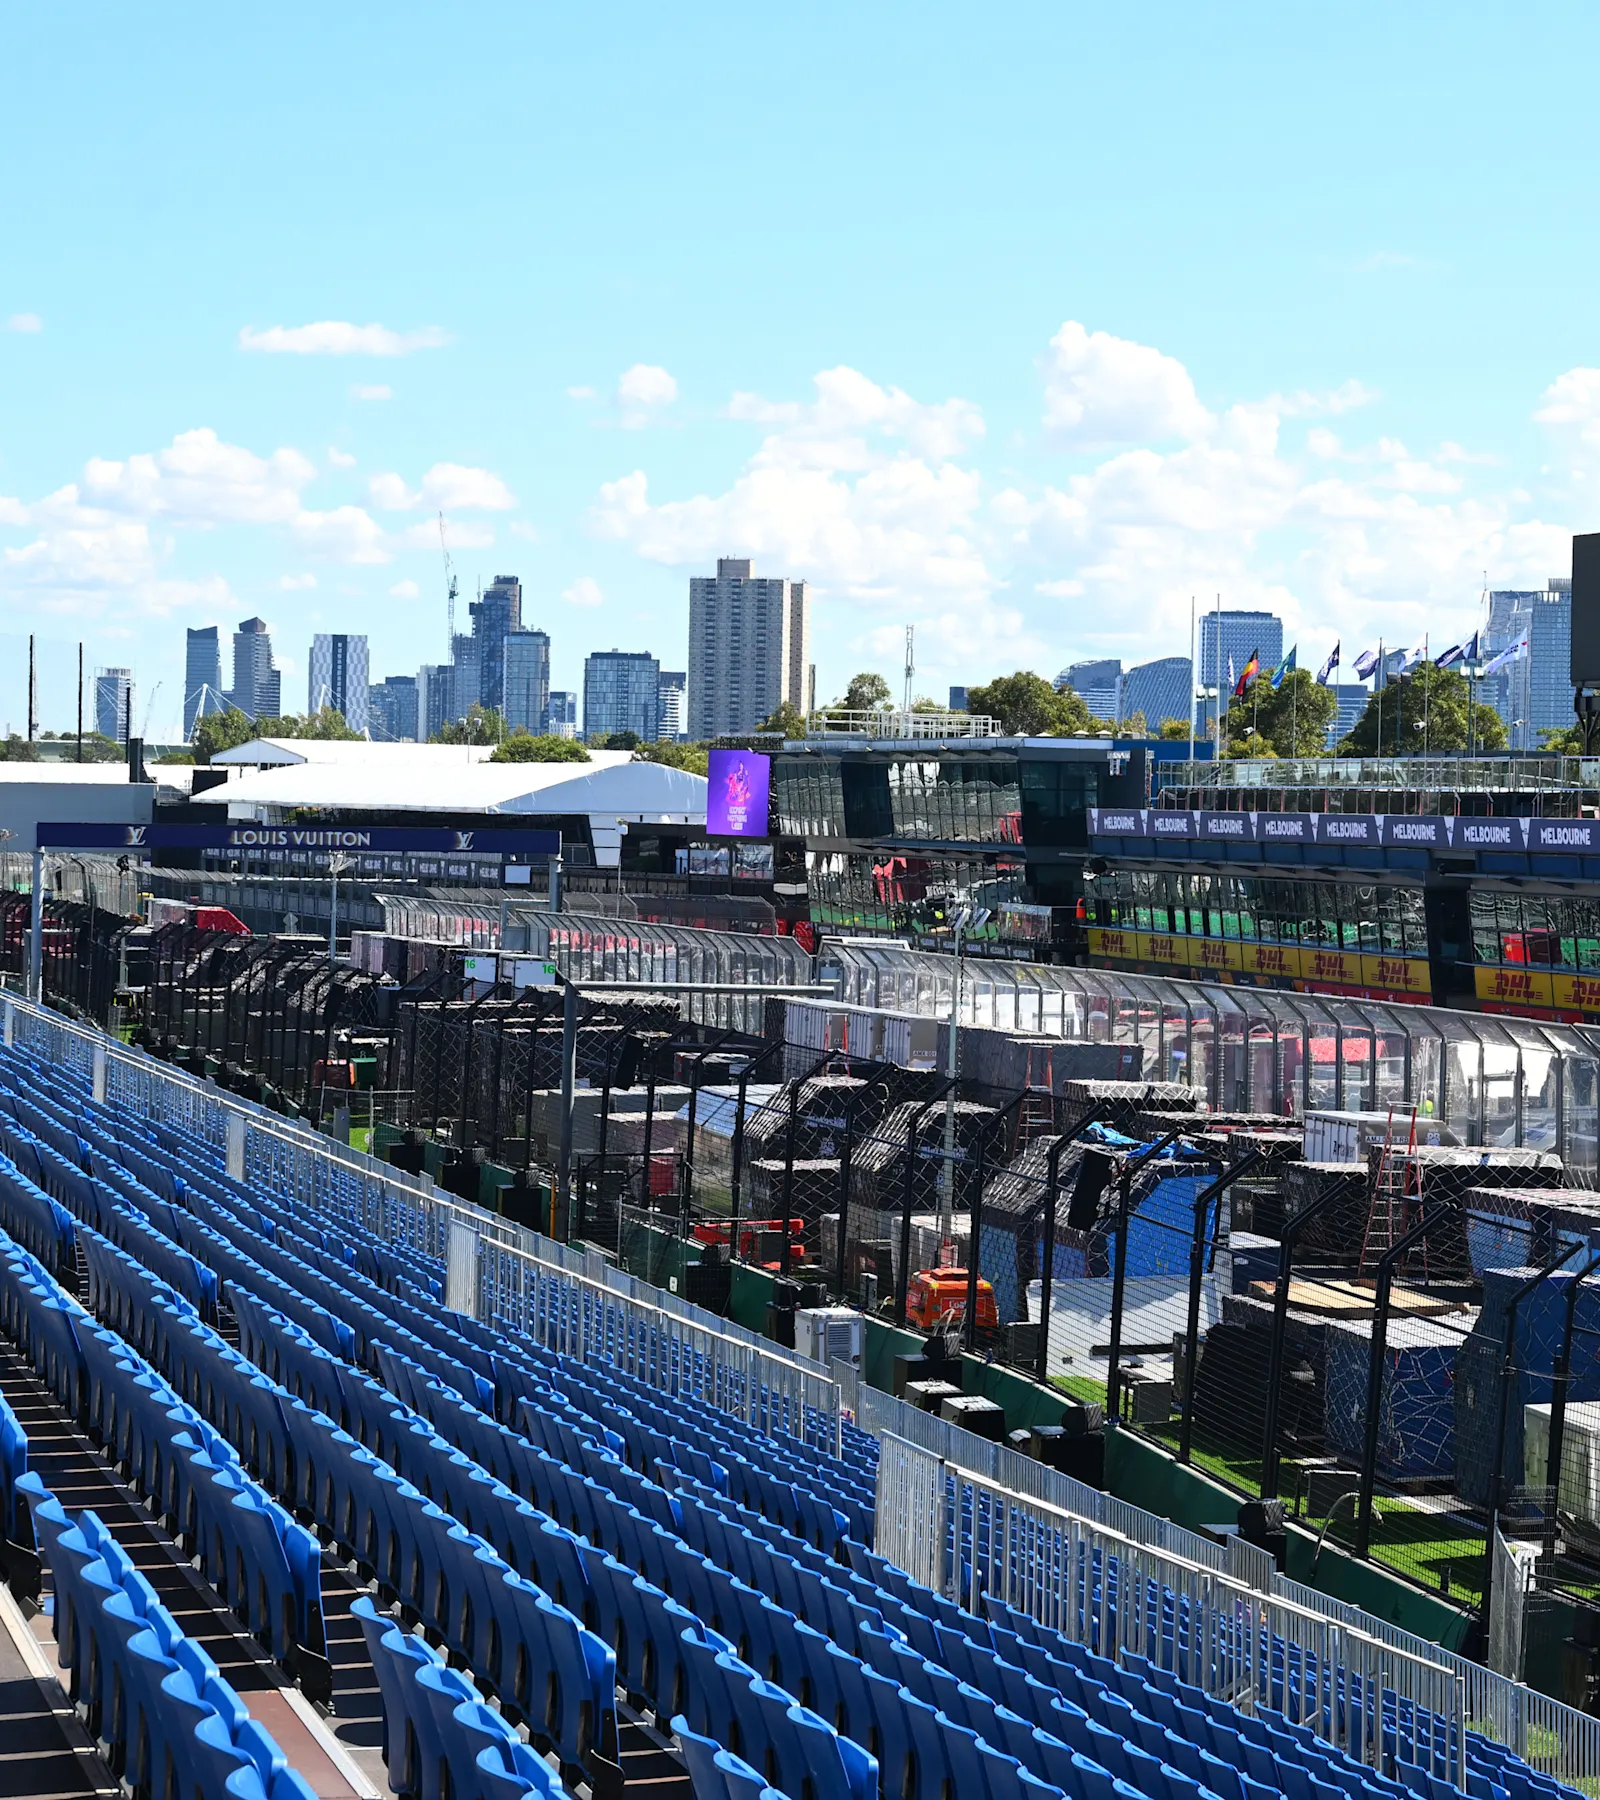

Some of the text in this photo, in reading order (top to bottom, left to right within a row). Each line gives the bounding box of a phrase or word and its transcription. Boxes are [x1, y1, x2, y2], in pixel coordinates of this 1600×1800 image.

[1104, 817, 1135, 830] MELBOURNE
[1154, 818, 1188, 832] MELBOURNE
[1208, 819, 1243, 834] MELBOURNE
[1265, 820, 1303, 836] MELBOURNE
[1327, 822, 1368, 837] MELBOURNE
[233, 830, 371, 847] LOUIS VUITTON
[1393, 824, 1436, 841] MELBOURNE
[1463, 826, 1511, 844] MELBOURNE
[1541, 828, 1591, 846] MELBOURNE
[1100, 933, 1126, 953] DHL
[1149, 938, 1175, 958] DHL
[1201, 943, 1229, 964] DHL
[1255, 948, 1286, 970] DHL
[465, 960, 476, 969] 16
[542, 965, 556, 974] 16
[1315, 954, 1347, 977] DHL
[1377, 960, 1412, 985] DHL
[1494, 974, 1536, 999] DHL
